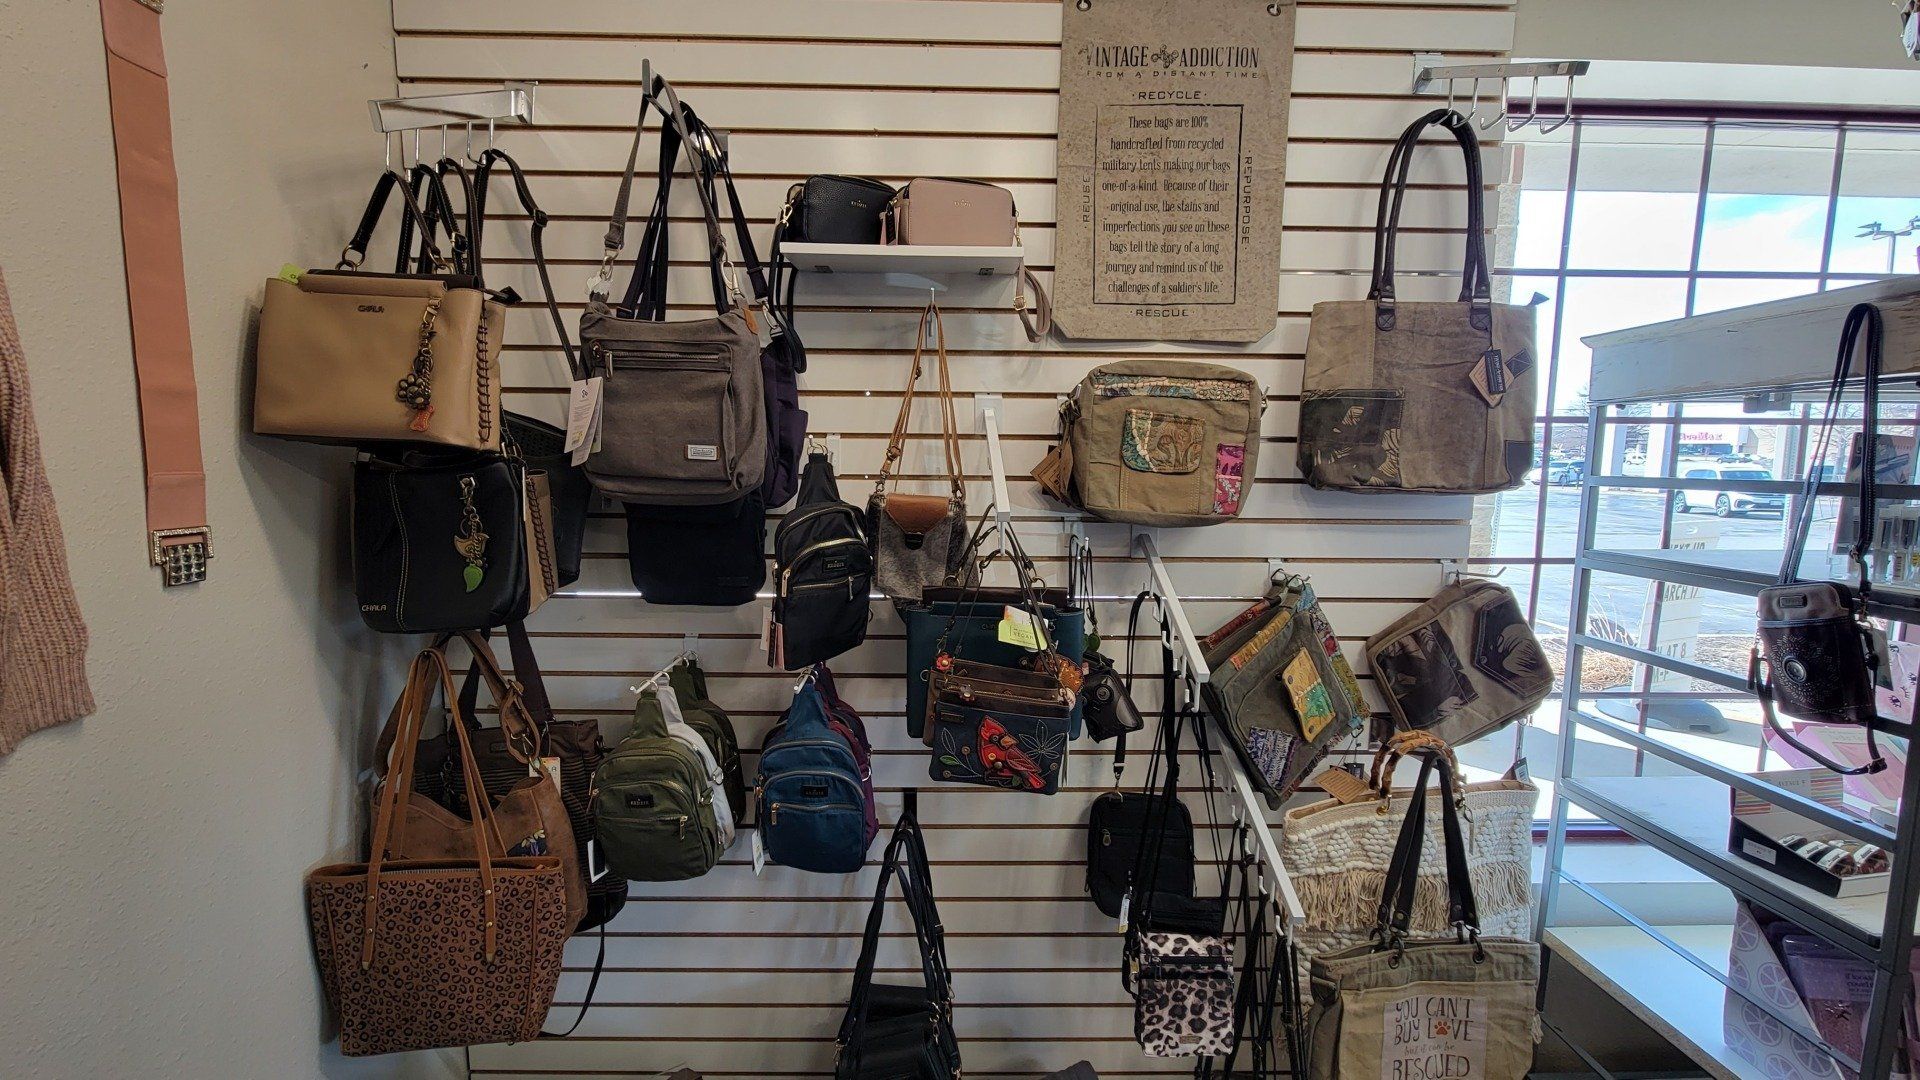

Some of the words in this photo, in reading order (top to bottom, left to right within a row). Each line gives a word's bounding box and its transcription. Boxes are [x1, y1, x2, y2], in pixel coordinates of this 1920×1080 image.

[1085, 45, 1149, 68] VINTAGE
[1179, 46, 1260, 68] ADDICTION
[1225, 71, 1258, 79] TIME
[1138, 90, 1202, 100] RECYCLE
[1128, 115, 1152, 129] These
[1154, 115, 1174, 130] bags
[1176, 117, 1190, 128] are
[1191, 115, 1209, 128] 100%
[1110, 137, 1163, 150] handcrafted
[1165, 137, 1186, 149] from
[1187, 138, 1225, 152] recycled
[1102, 158, 1137, 173] military
[1139, 160, 1161, 171] tents
[1163, 159, 1194, 173] making
[1195, 161, 1211, 171] our
[1212, 160, 1231, 173] bags
[1163, 179, 1197, 192] Because
[1198, 179, 1208, 192] of
[1209, 180, 1230, 192] their
[1082, 174, 1091, 223] REUSE
[1241, 156, 1254, 245] REPURPOSE
[1110, 201, 1142, 214] original
[1144, 203, 1160, 214] use,
[1162, 201, 1175, 212] the
[1177, 201, 1202, 213] stains
[1204, 201, 1220, 213] and
[1103, 220, 1160, 234] imperfections
[1162, 223, 1178, 235] you
[1180, 223, 1193, 233] see
[1194, 223, 1205, 233] on
[1207, 220, 1230, 233] these
[1109, 241, 1128, 254] bags
[1130, 241, 1143, 253] tell
[1145, 241, 1159, 253] the
[1160, 241, 1182, 255] story
[1184, 241, 1194, 253] of
[1194, 244, 1200, 253] a
[1202, 241, 1220, 255] long
[1104, 262, 1137, 275] journey
[1139, 262, 1154, 273] and
[1156, 262, 1185, 273] remind
[1187, 263, 1198, 273] us
[1199, 262, 1209, 273] of
[1210, 261, 1223, 272] the
[1108, 281, 1150, 294] challenges
[1152, 281, 1161, 293] of
[1161, 284, 1166, 293] a
[1168, 281, 1201, 293] soldier's
[1204, 281, 1220, 293] life.
[1136, 309, 1189, 318] RESCUE
[1664, 584, 1688, 602] ARCH
[361, 604, 387, 612] CHALA
[1395, 997, 1419, 1023] YOU
[1426, 996, 1474, 1019] CAN'T
[1394, 1018, 1420, 1045] BUY
[1427, 1017, 1474, 1042] LVE
[1392, 1053, 1471, 1080] RESCUED
